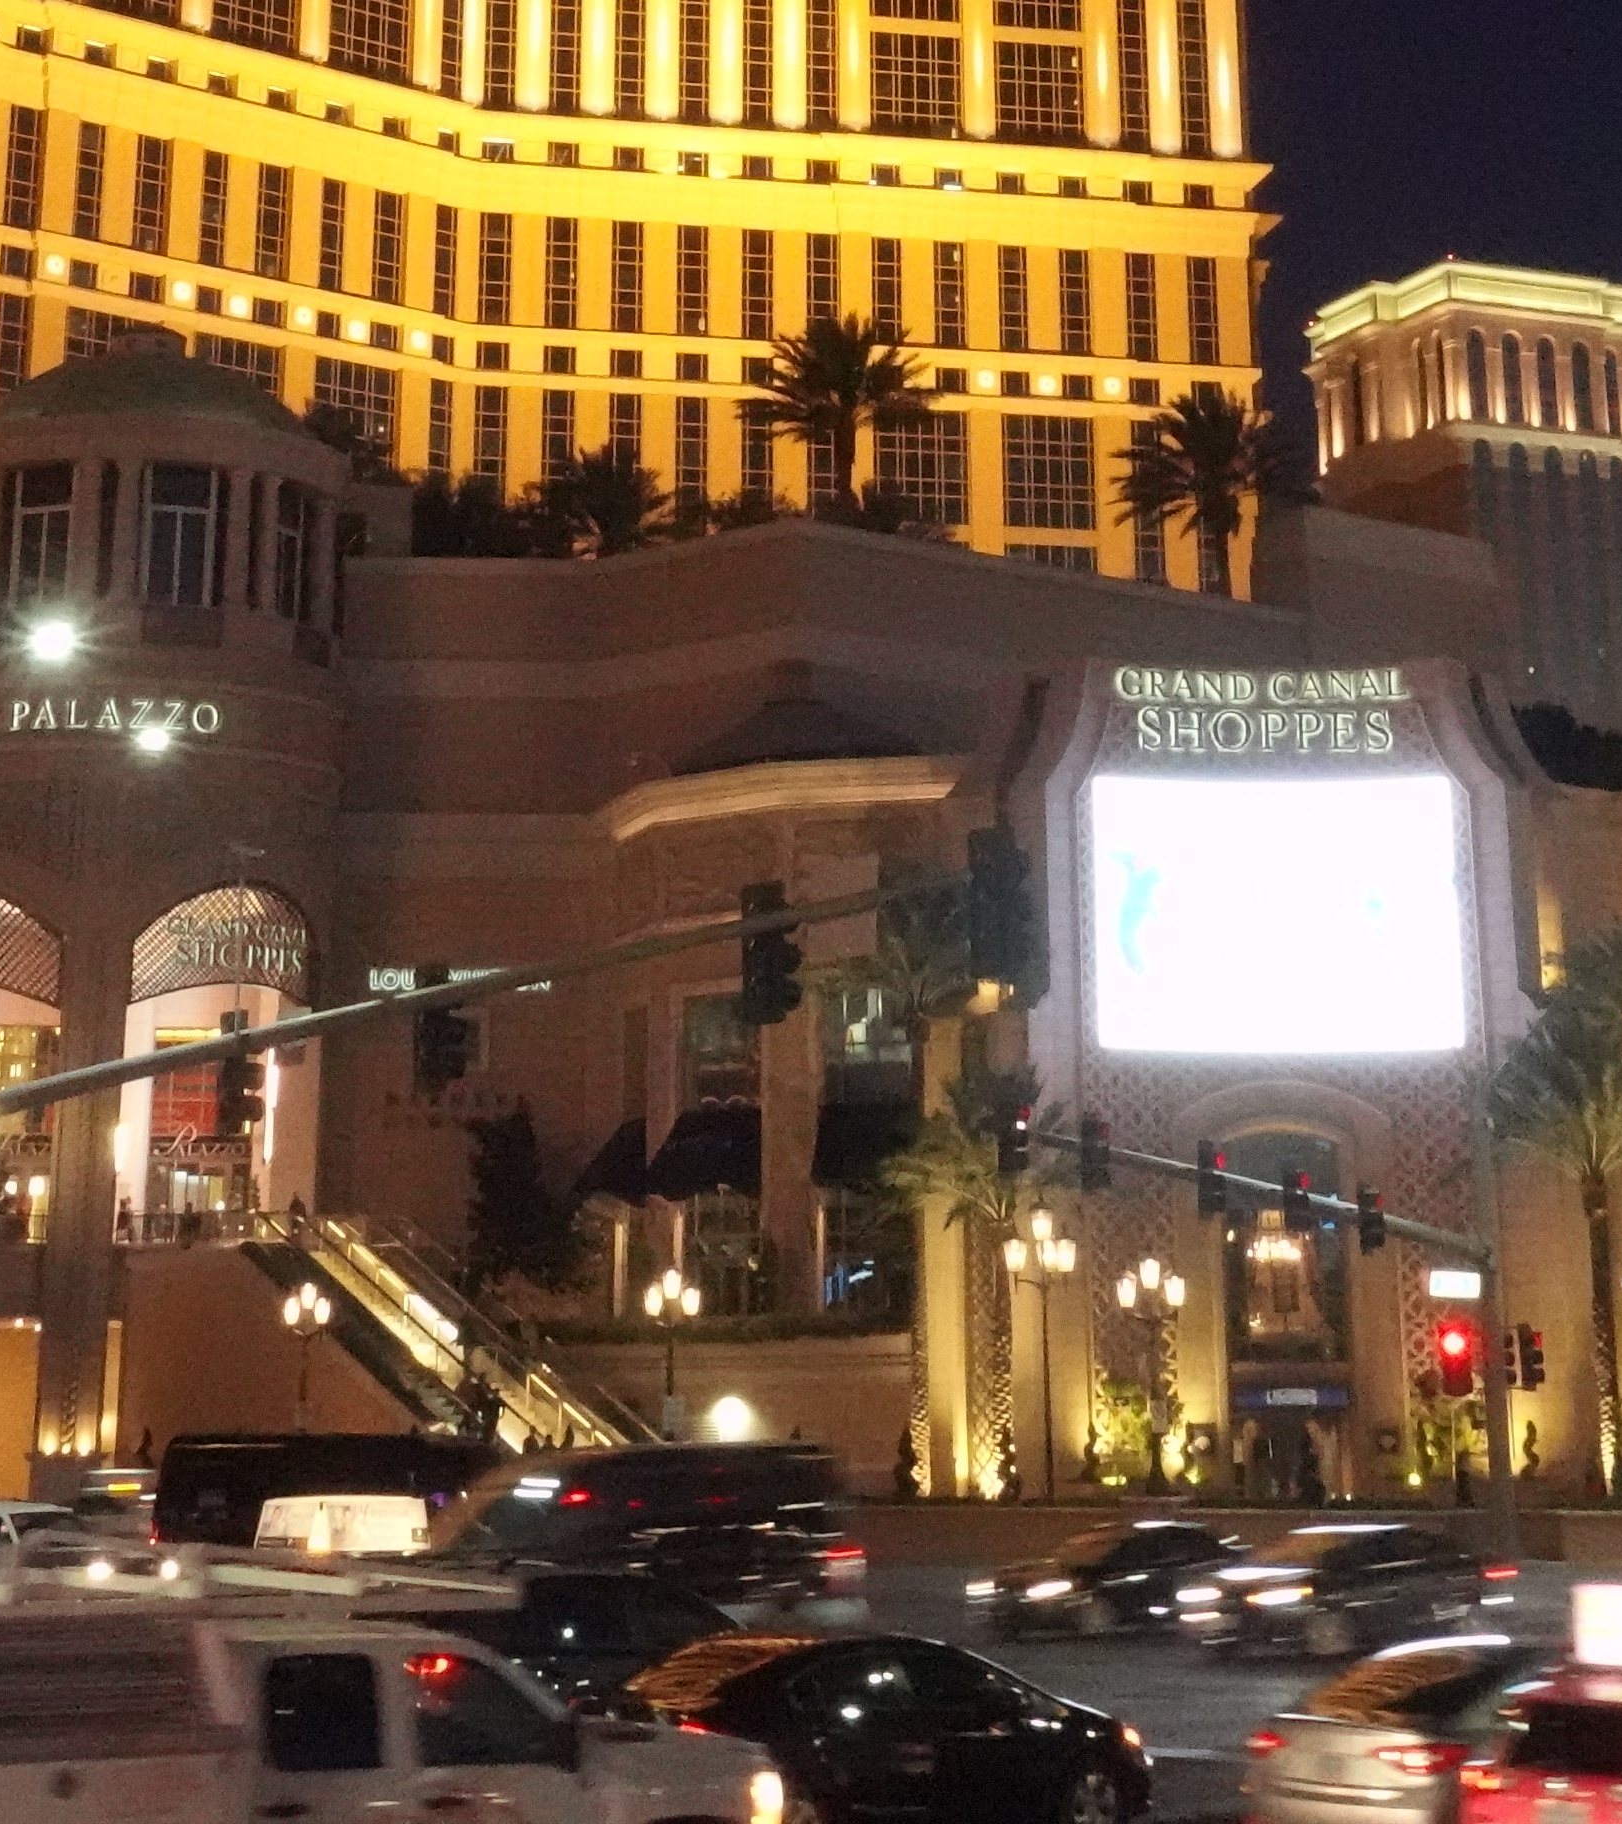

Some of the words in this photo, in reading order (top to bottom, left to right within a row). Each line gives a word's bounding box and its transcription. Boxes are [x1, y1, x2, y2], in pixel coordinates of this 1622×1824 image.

[1116, 667, 1256, 704] GRAND
[1268, 666, 1410, 702] CANAL
[9, 698, 222, 735] PALAZZO
[1137, 707, 1394, 754] SHOPPES
[368, 967, 417, 992] LOU
